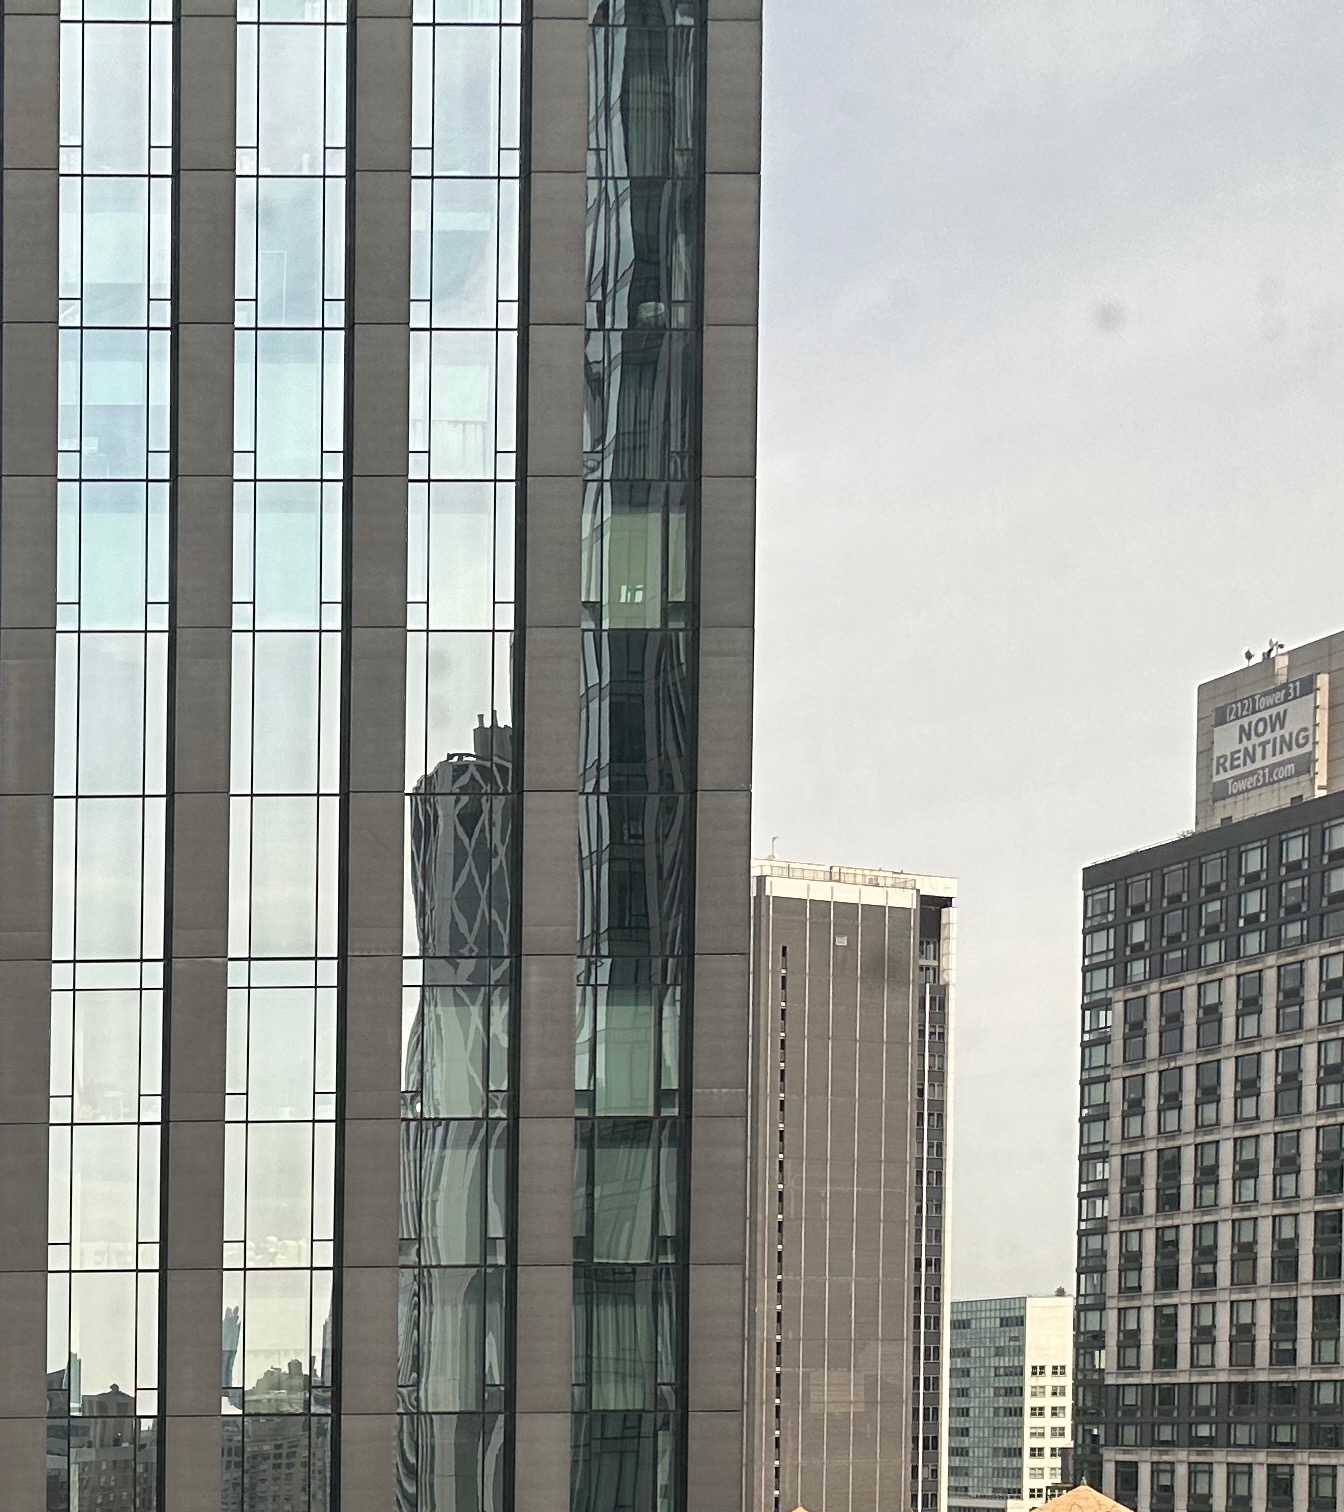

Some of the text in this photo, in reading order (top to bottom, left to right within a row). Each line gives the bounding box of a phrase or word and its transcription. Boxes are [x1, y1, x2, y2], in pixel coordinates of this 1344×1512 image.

[1226, 680, 1300, 722] (212) Tower 31
[1238, 708, 1288, 744] NOW
[1215, 727, 1309, 775] RENTING
[1227, 762, 1295, 795] Tower31.com
